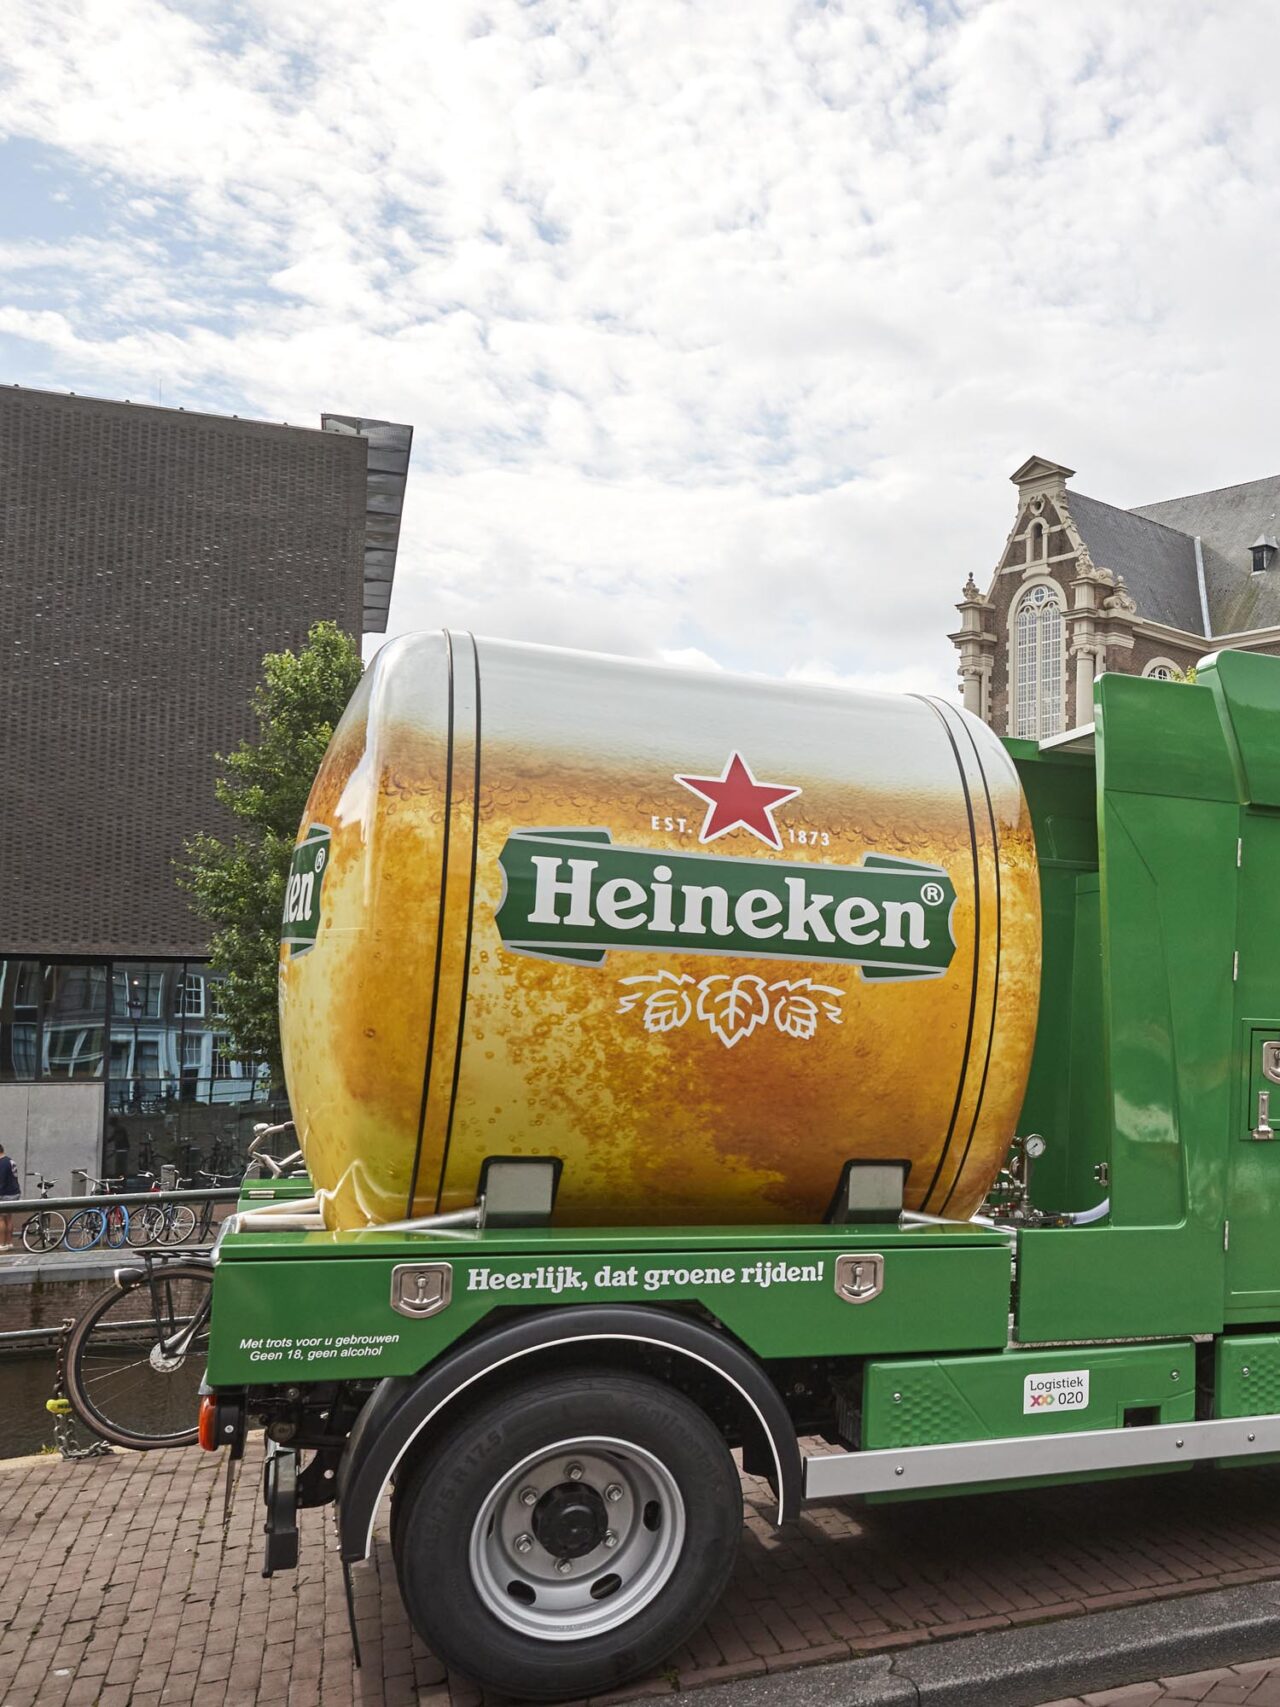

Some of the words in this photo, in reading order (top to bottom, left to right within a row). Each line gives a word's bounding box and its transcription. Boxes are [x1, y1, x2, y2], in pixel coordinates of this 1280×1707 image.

[651, 816, 693, 834] EST.
[788, 829, 830, 846] 1873
[467, 1266, 588, 1294] Heerlijk,
[594, 1265, 639, 1287] dat
[643, 1267, 736, 1291] groene
[740, 1261, 825, 1288] rijden!
[239, 1338, 263, 1350] Met
[265, 1338, 293, 1349] trots
[295, 1337, 322, 1347] voor
[324, 1337, 332, 1346] u
[335, 1334, 400, 1348] gebrouwen
[249, 1350, 283, 1362] Geen
[287, 1349, 304, 1361] 18,
[307, 1349, 338, 1361] geen
[340, 1346, 383, 1357] alcohol
[1030, 1376, 1084, 1393] Logistiek
[1058, 1391, 1084, 1405] 020
